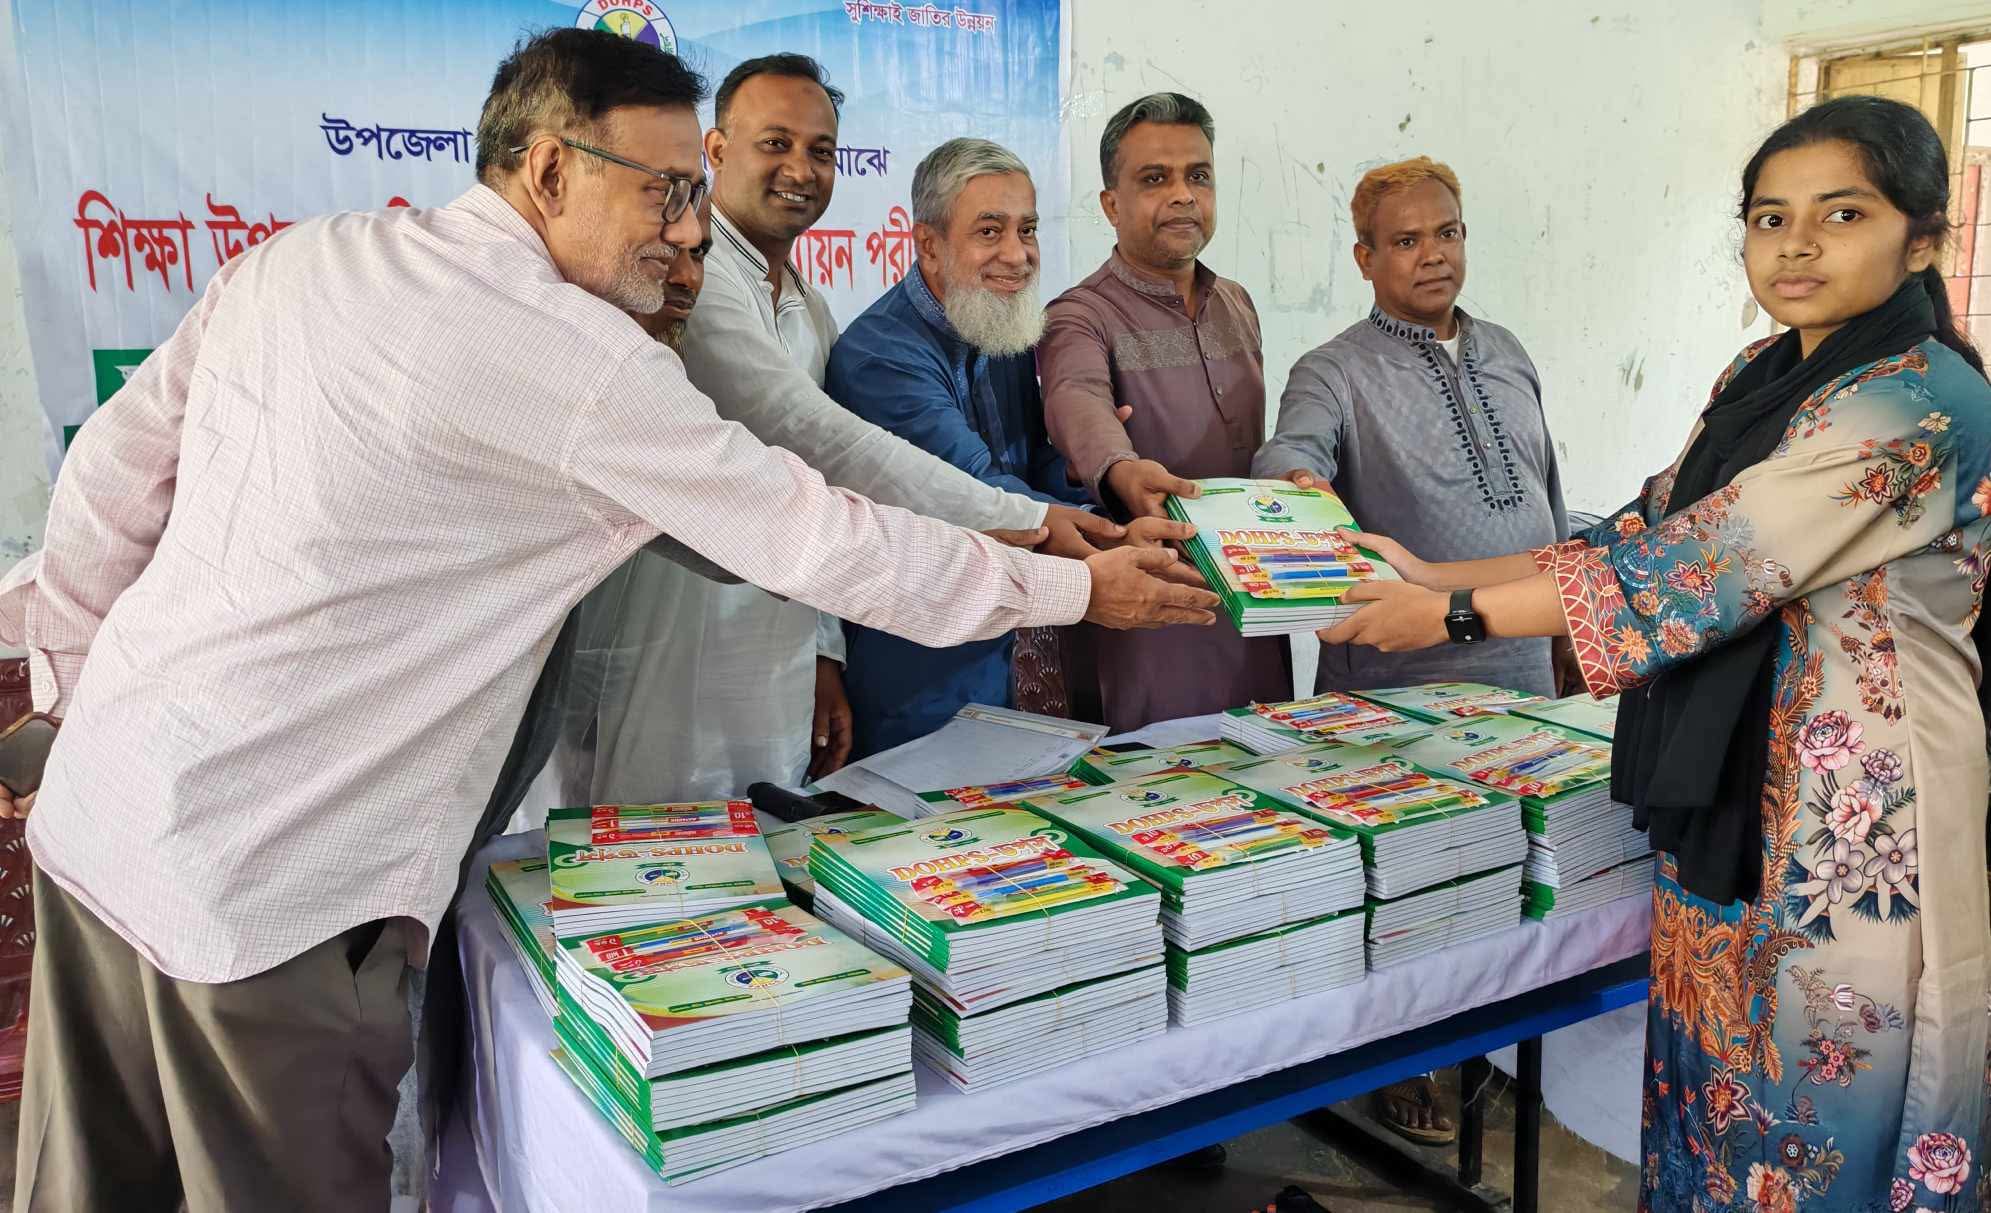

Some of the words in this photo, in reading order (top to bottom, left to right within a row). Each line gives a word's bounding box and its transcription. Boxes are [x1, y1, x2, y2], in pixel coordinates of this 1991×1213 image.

[845, 0, 904, 26] সুশিক্ষাই
[906, 5, 951, 27] জাতির
[954, 7, 996, 32] উন্নয়ন
[320, 112, 474, 164] উপজেলা
[73, 189, 196, 294] শিক্ষা
